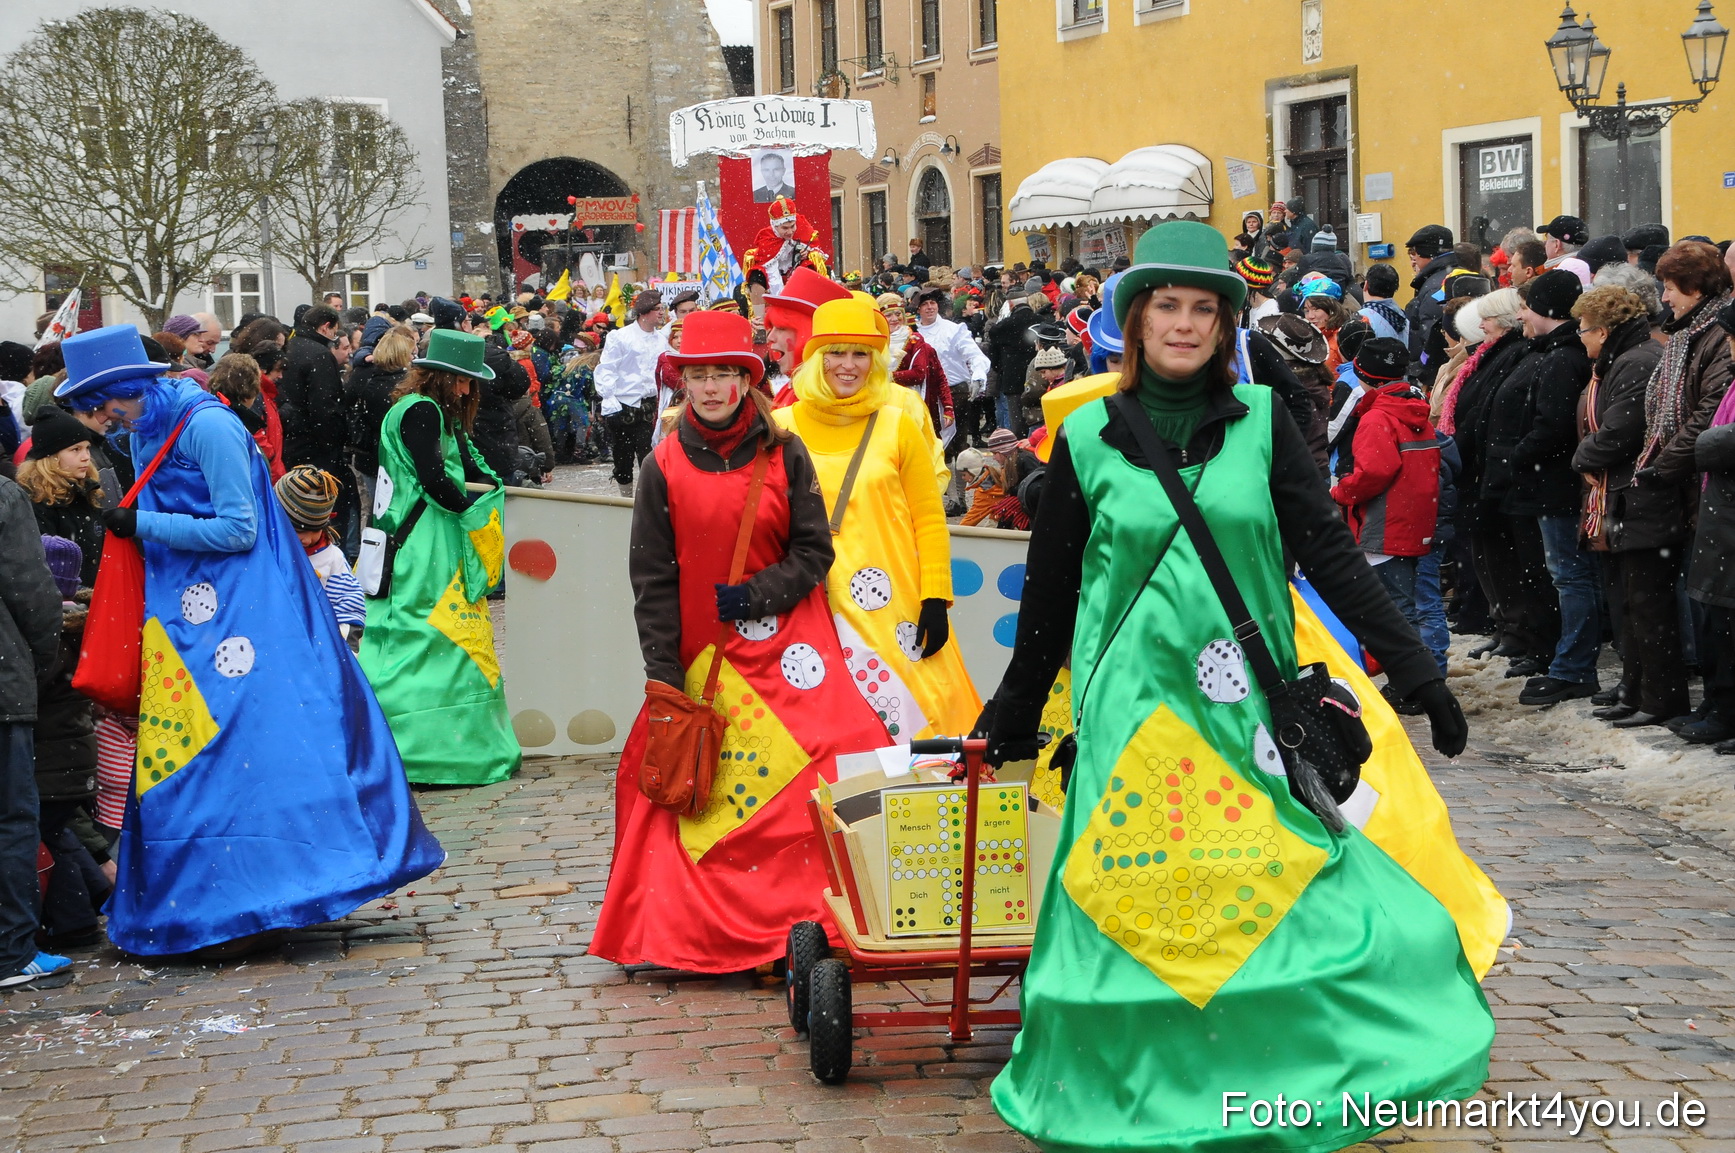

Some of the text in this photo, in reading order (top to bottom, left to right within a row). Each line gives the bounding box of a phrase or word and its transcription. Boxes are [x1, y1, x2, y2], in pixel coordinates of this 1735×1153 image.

[695, 102, 836, 131] König Ludwig I.
[729, 126, 796, 143] von Bacham
[1481, 148, 1521, 174] BW
[1480, 177, 1523, 191] Bekleidung
[900, 819, 1011, 832] Mensch ärgere
[909, 886, 1010, 899] Dich nicht
